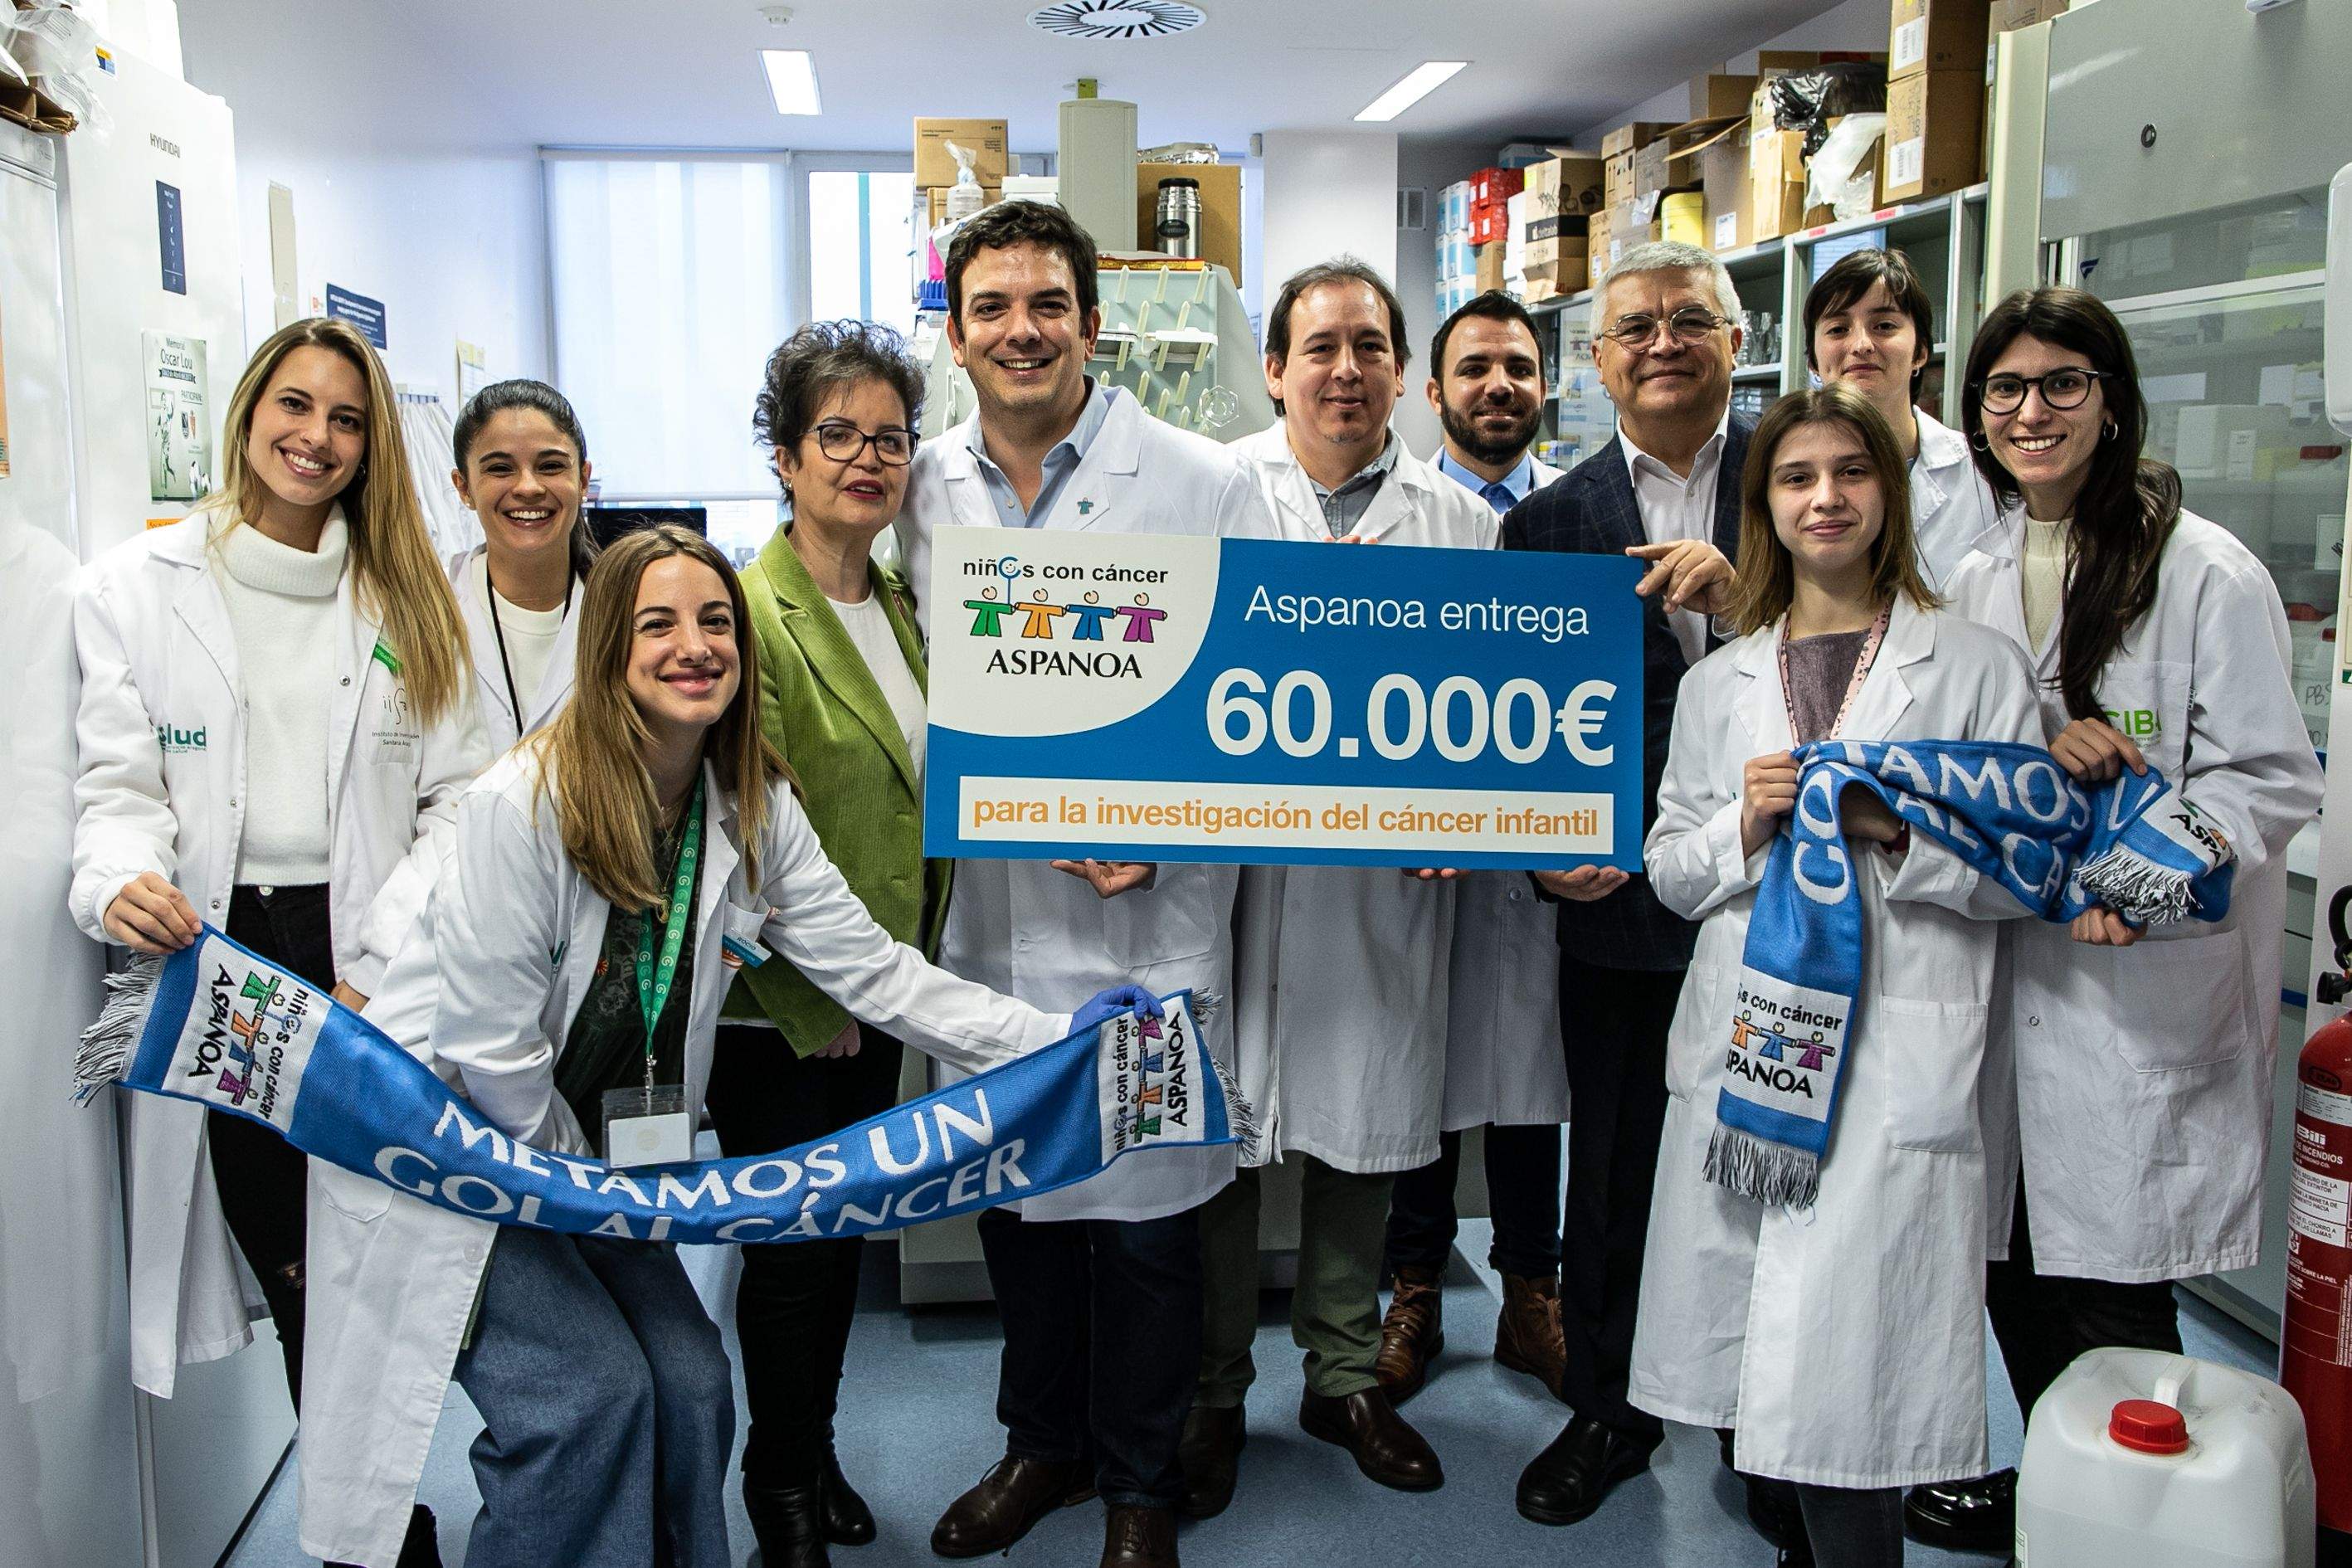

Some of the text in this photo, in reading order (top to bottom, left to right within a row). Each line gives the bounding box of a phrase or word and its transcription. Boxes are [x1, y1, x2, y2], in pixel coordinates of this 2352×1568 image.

[149, 132, 181, 158] HYUNDAI
[180, 353, 193, 370] Lou
[1042, 565, 1084, 580] con
[1092, 563, 1169, 583] cáncer
[1244, 585, 1590, 644] Aspanoa entrega
[986, 648, 1143, 679] ASPANOA
[1205, 666, 1618, 767] 60.000€
[973, 796, 1598, 836] para la investigación del cáncer infantil
[2169, 814, 2223, 869] ASPA
[187, 962, 236, 1078] ASPANOA
[1751, 994, 1777, 1015] con
[1780, 1004, 1843, 1031] cáncer
[268, 1045, 285, 1075] con
[1113, 1018, 1128, 1071] cáncer
[1166, 1010, 1188, 1127] ASPANOA
[257, 1074, 280, 1120] cáncer
[1117, 1074, 1128, 1103] con
[432, 1088, 994, 1210] METAMOS UN
[2302, 1144, 2344, 1165] INCENDIOS
[373, 1145, 554, 1228] GOL
[715, 1137, 1031, 1242] CÁNCER
[2306, 1181, 2332, 1194] EXTINTOR
[2312, 1202, 2330, 1213] HACIA
[2307, 1220, 2331, 1232] CHORRO
[2310, 1228, 2333, 1239] LLAMAS
[2301, 1267, 2316, 1278] SOBRE
[2324, 1275, 2338, 1285] PIEL
